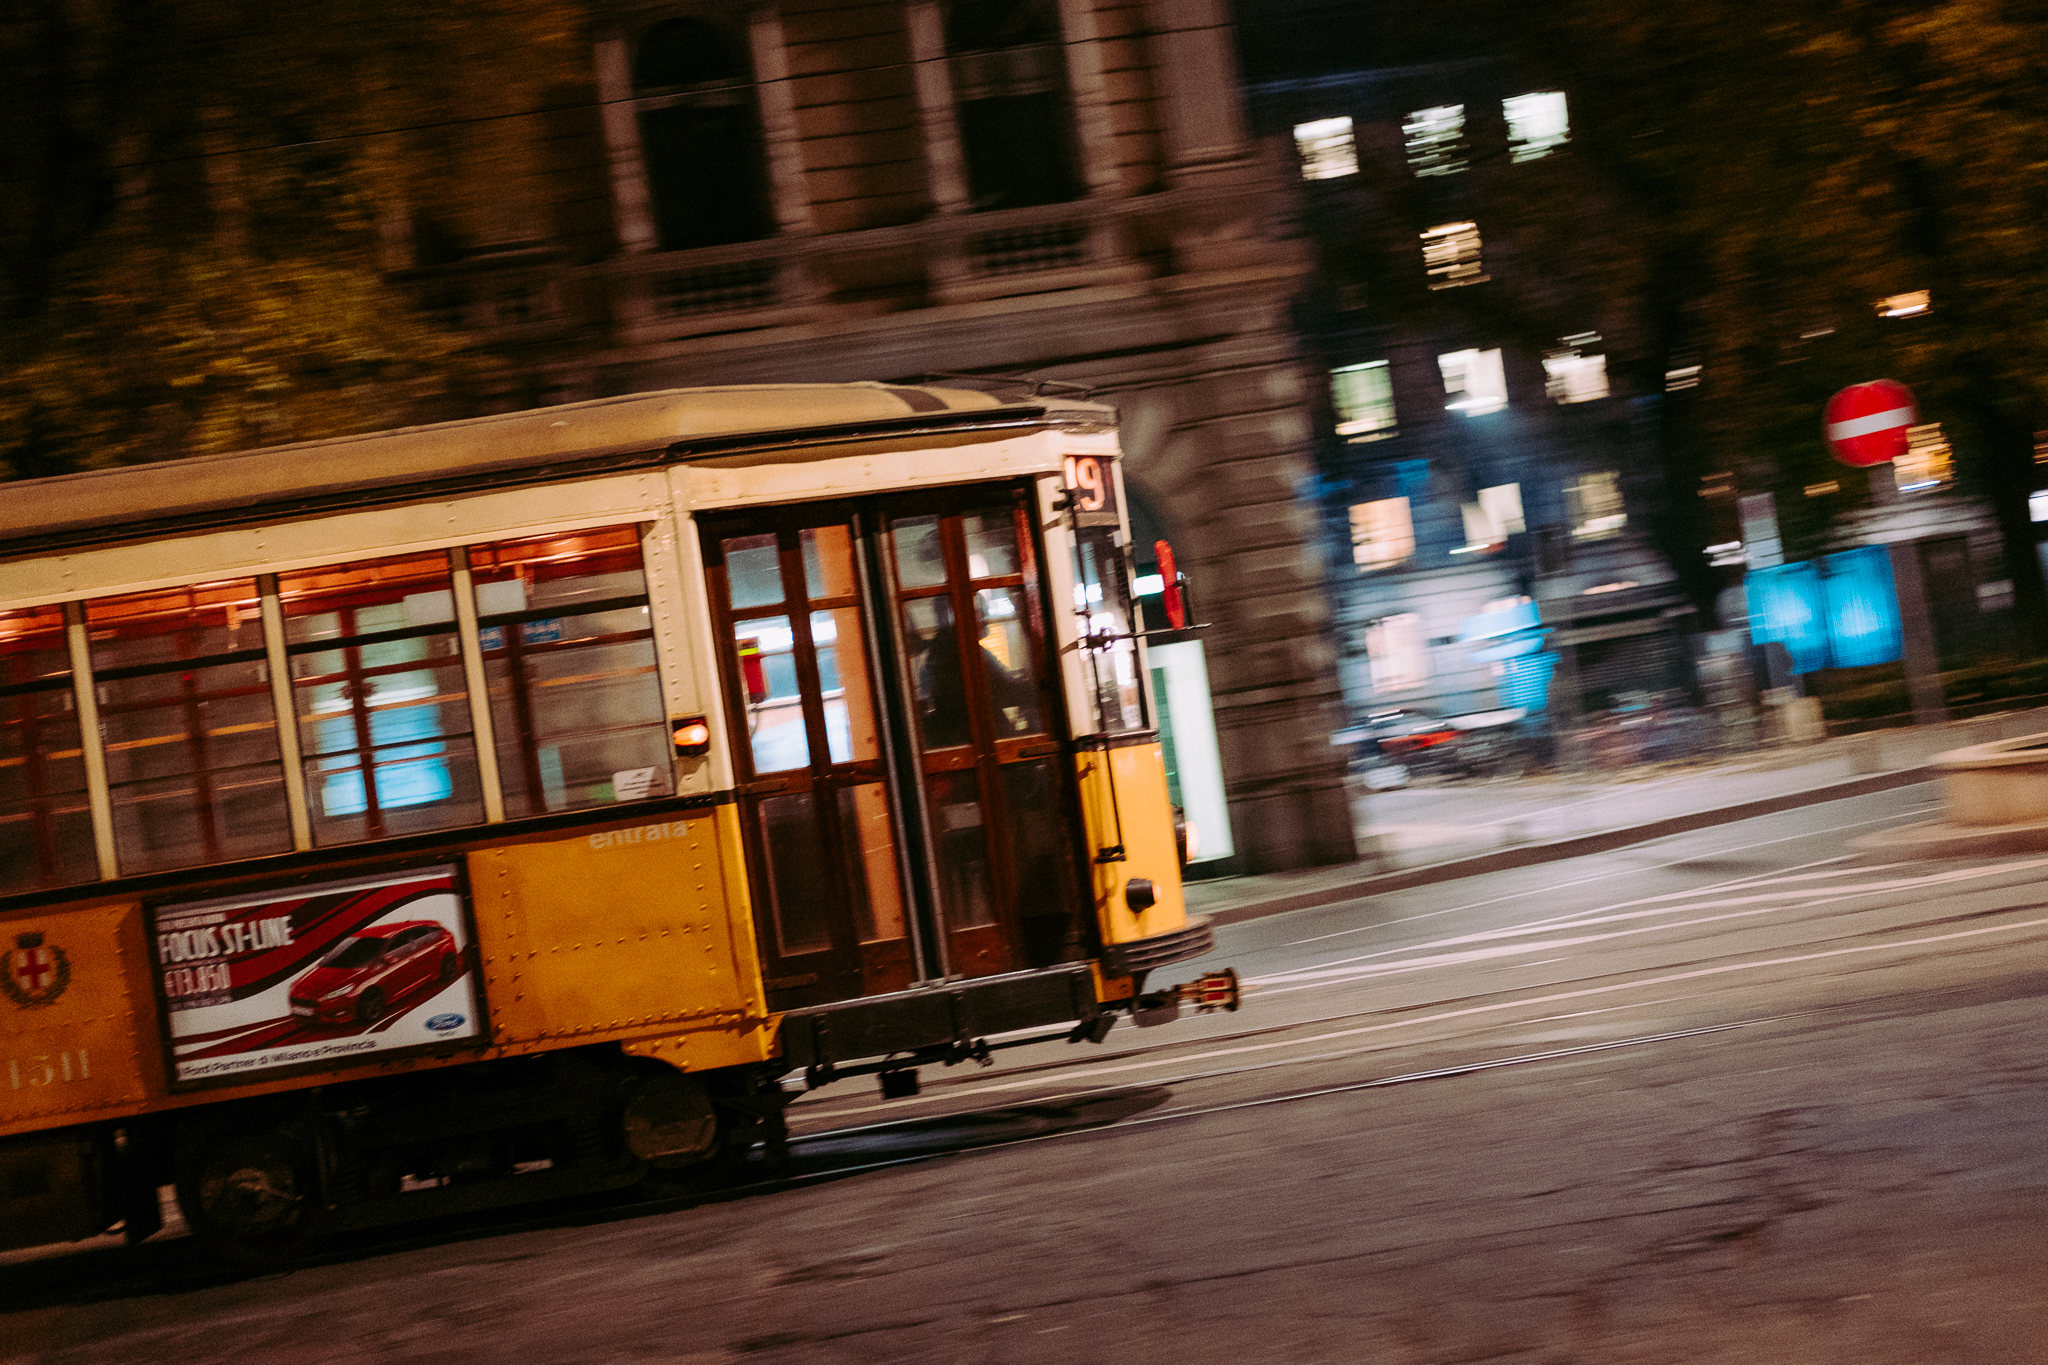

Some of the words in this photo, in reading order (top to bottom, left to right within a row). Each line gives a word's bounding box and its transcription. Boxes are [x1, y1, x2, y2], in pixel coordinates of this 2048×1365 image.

[1063, 456, 1105, 511] 19
[589, 821, 688, 849] entrata
[158, 926, 220, 965] FOCUS
[9, 1049, 89, 1090] 1511
